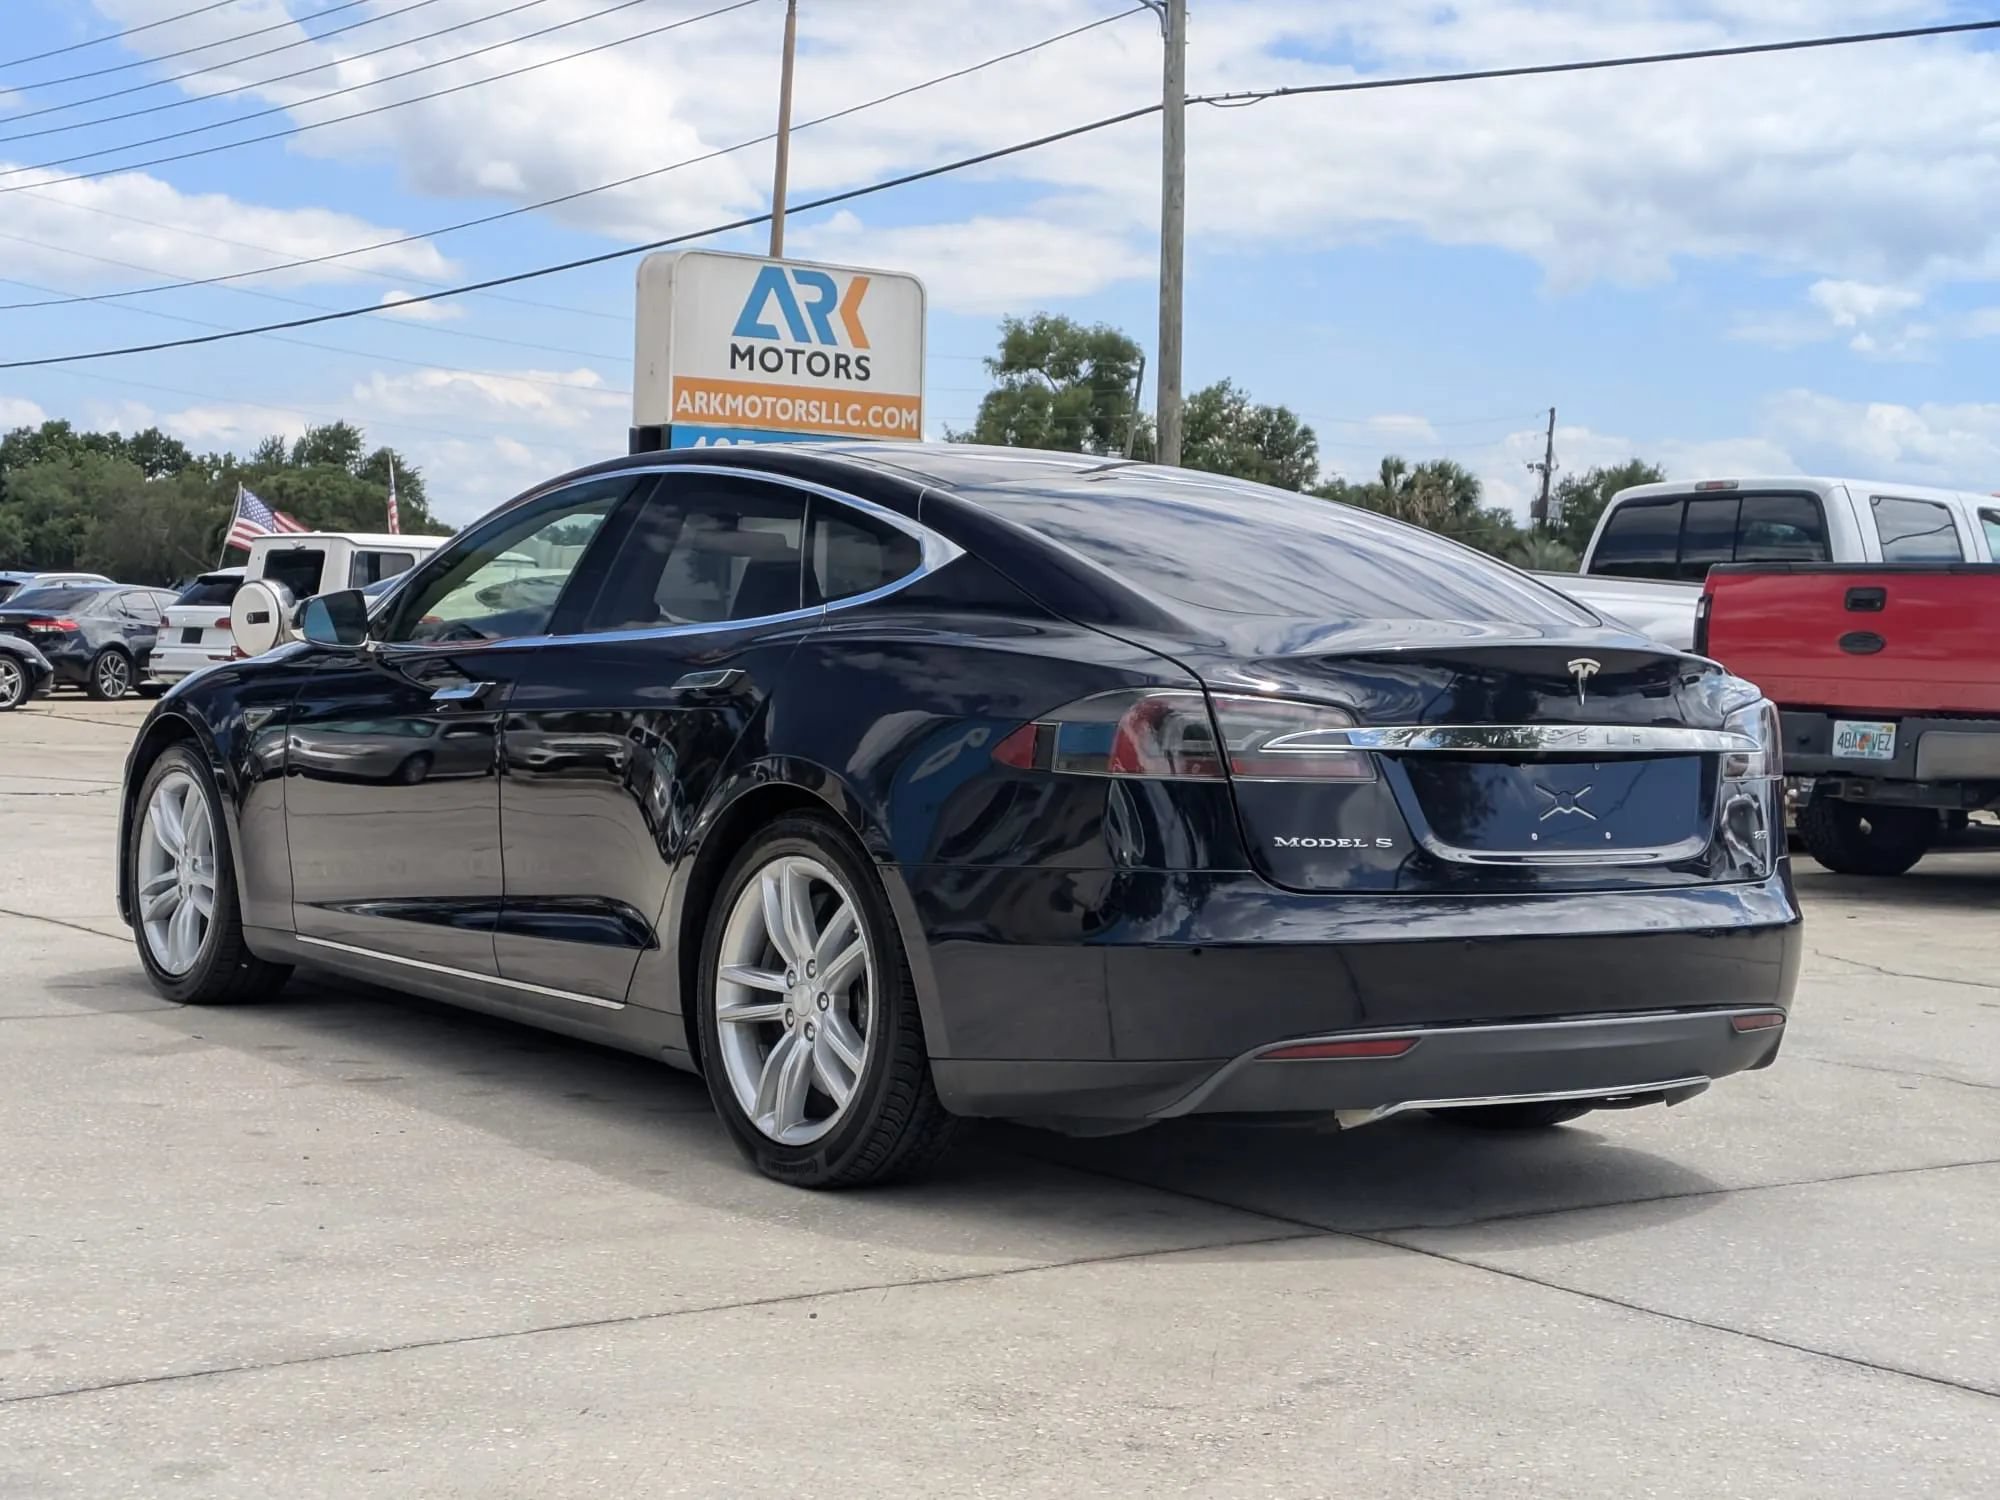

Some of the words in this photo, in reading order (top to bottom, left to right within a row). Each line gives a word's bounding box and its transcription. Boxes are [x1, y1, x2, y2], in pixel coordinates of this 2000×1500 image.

[732, 265, 870, 349] ARK
[730, 343, 871, 381] MOTORS
[676, 389, 918, 431] ARKMOTORSLLC.COM
[1274, 836, 1368, 848] MODEL
[1375, 838, 1393, 848] S
